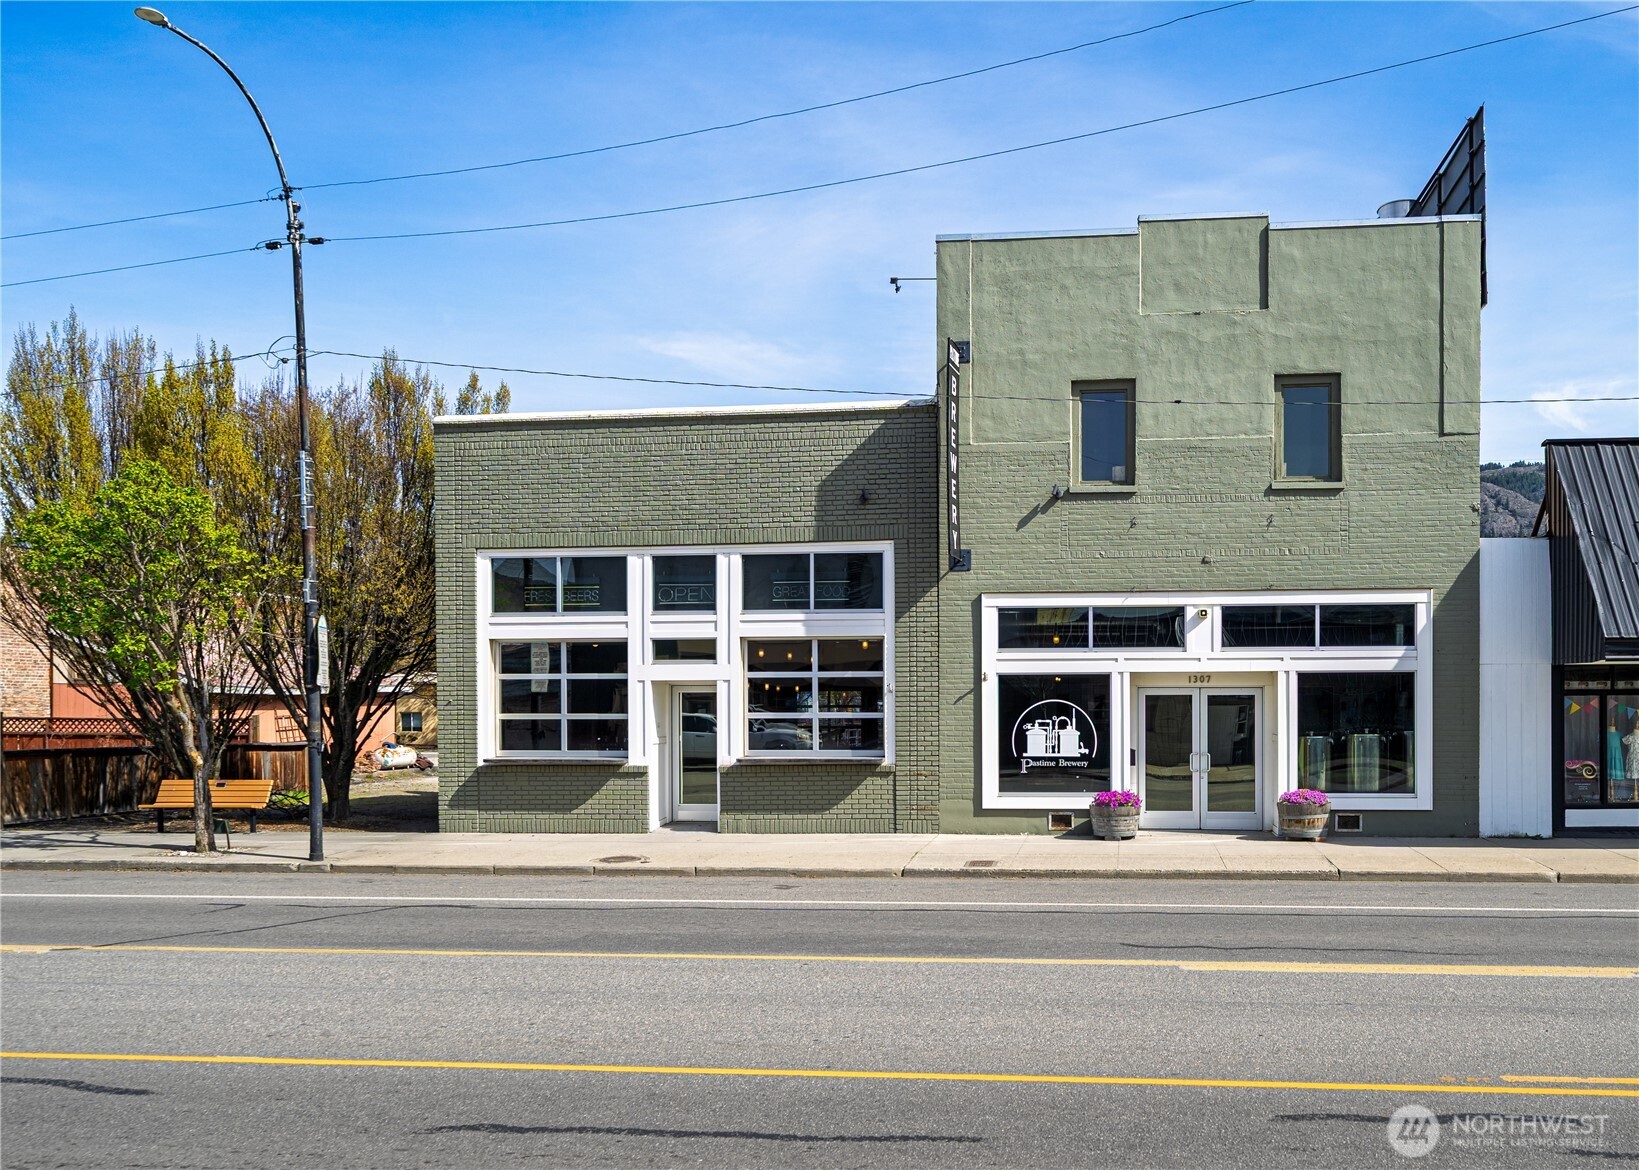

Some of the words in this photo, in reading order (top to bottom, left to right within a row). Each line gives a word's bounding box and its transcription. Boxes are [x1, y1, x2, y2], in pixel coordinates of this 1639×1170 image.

[950, 376, 958, 549] BREWERY
[524, 590, 557, 602] FRES
[563, 589, 599, 602] BEERS
[658, 586, 715, 602] OPEN
[816, 584, 850, 598] FOOD
[1188, 675, 1211, 684] 1307
[1020, 758, 1056, 774] Pastime
[1058, 758, 1089, 768] Brewery
